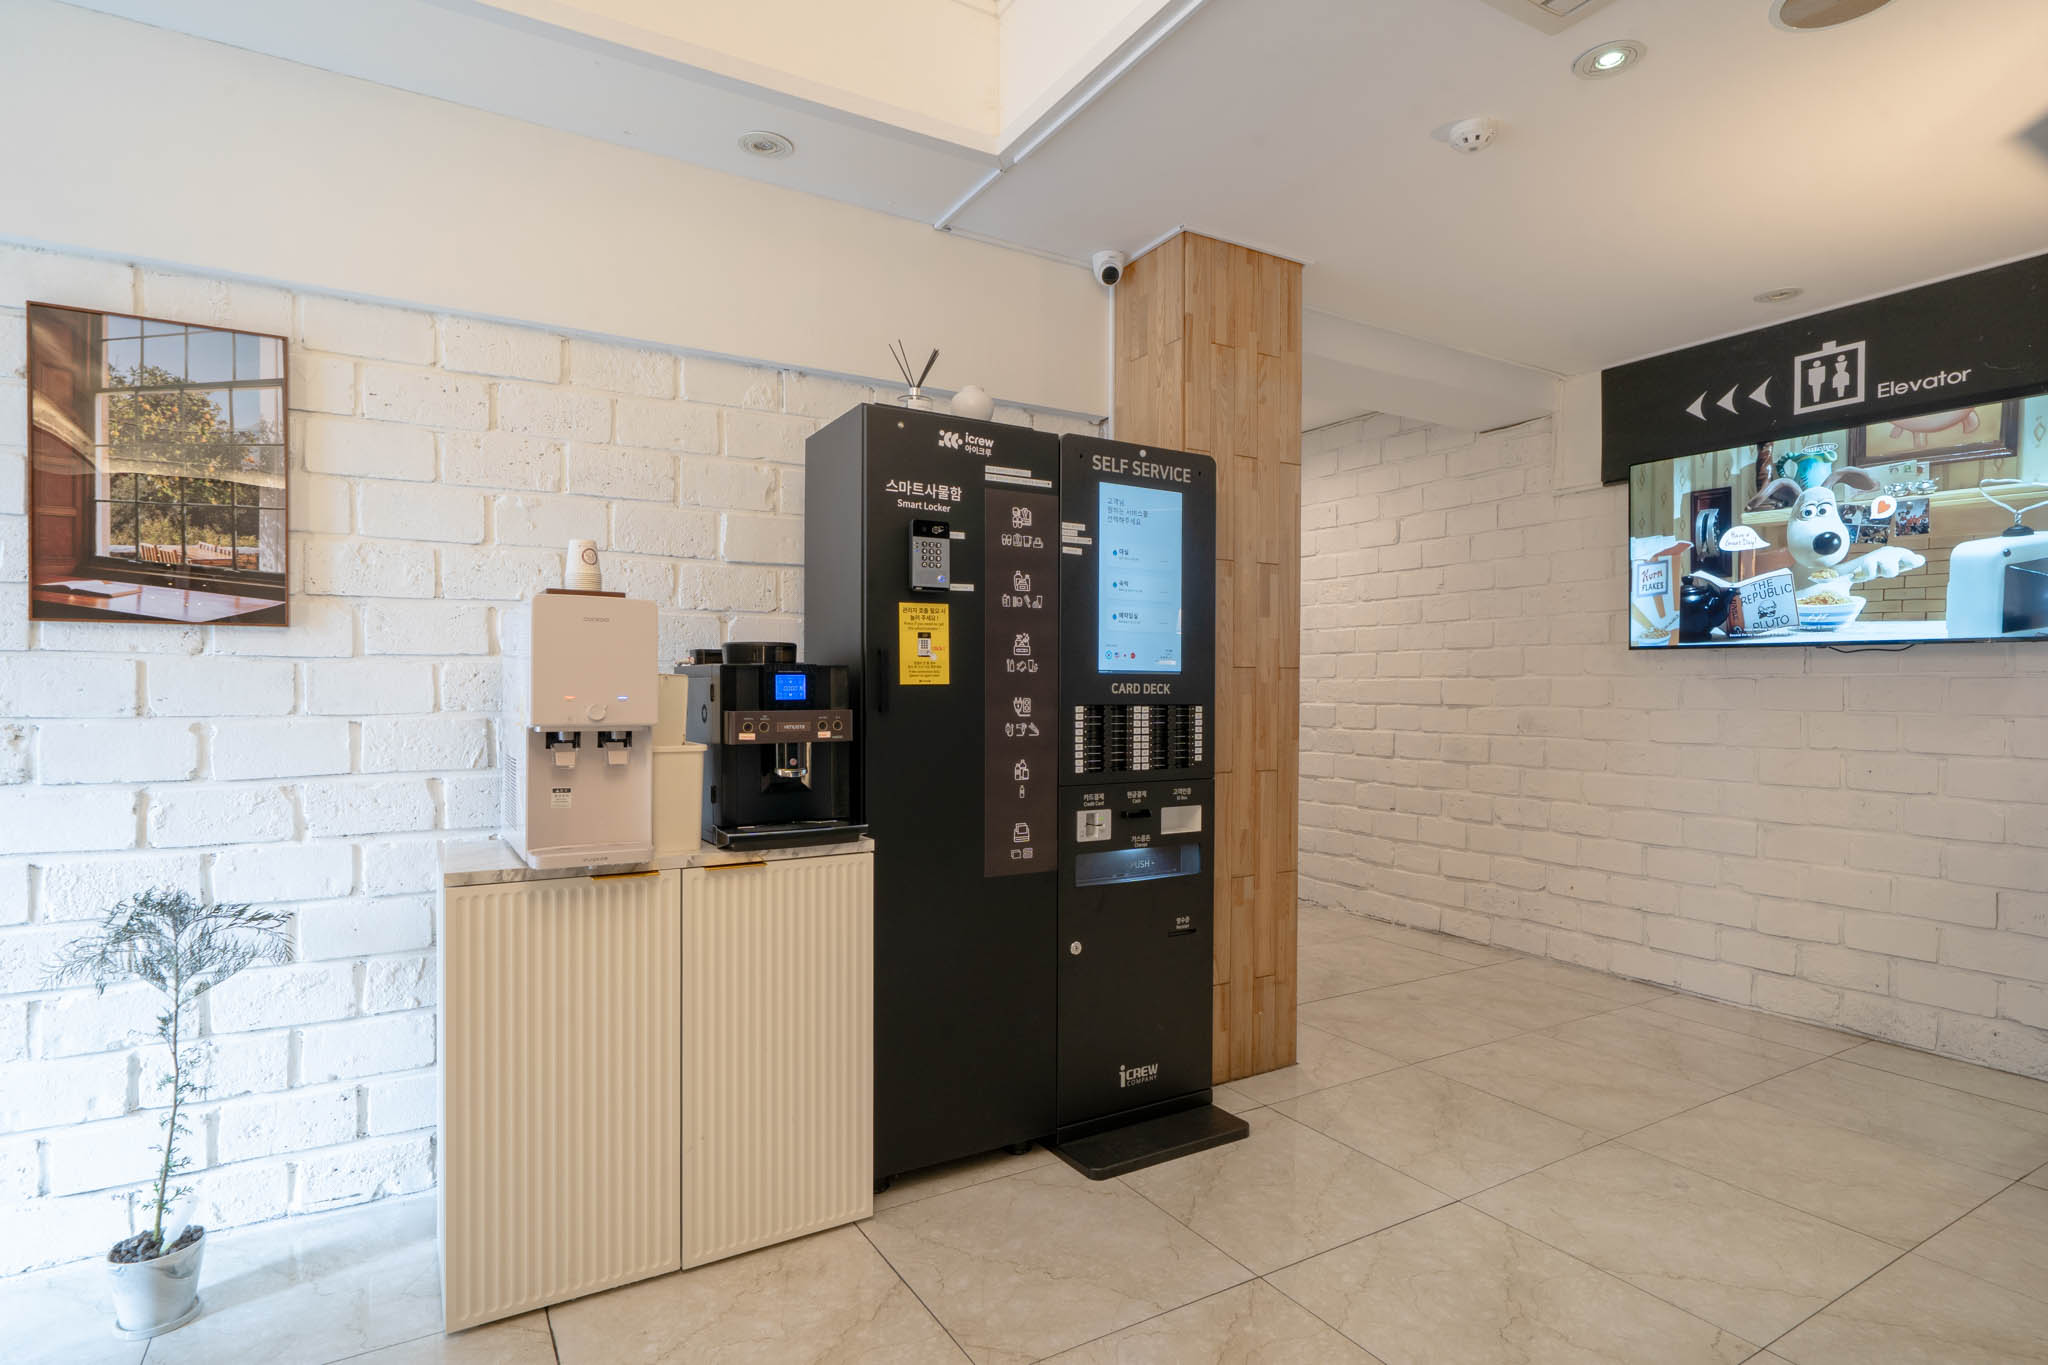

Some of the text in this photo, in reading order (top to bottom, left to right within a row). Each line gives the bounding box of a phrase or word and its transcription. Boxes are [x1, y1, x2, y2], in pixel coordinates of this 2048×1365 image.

[1877, 368, 1972, 398] Elevator
[965, 432, 994, 448] icrew
[965, 445, 992, 457] 아이크루
[1092, 455, 1192, 483] SELF SERVICE
[885, 479, 963, 502] 스마트사물함
[897, 498, 951, 513] Smart Locker
[1642, 581, 1664, 592] FLAKES
[1752, 579, 1774, 591] THE
[1741, 583, 1793, 605] REPUBLIC
[1752, 614, 1790, 629] PLUTO
[1111, 683, 1171, 695] CARD DECK
[1083, 793, 1104, 801] 카드결제
[1127, 1075, 1158, 1087] COMPANY
